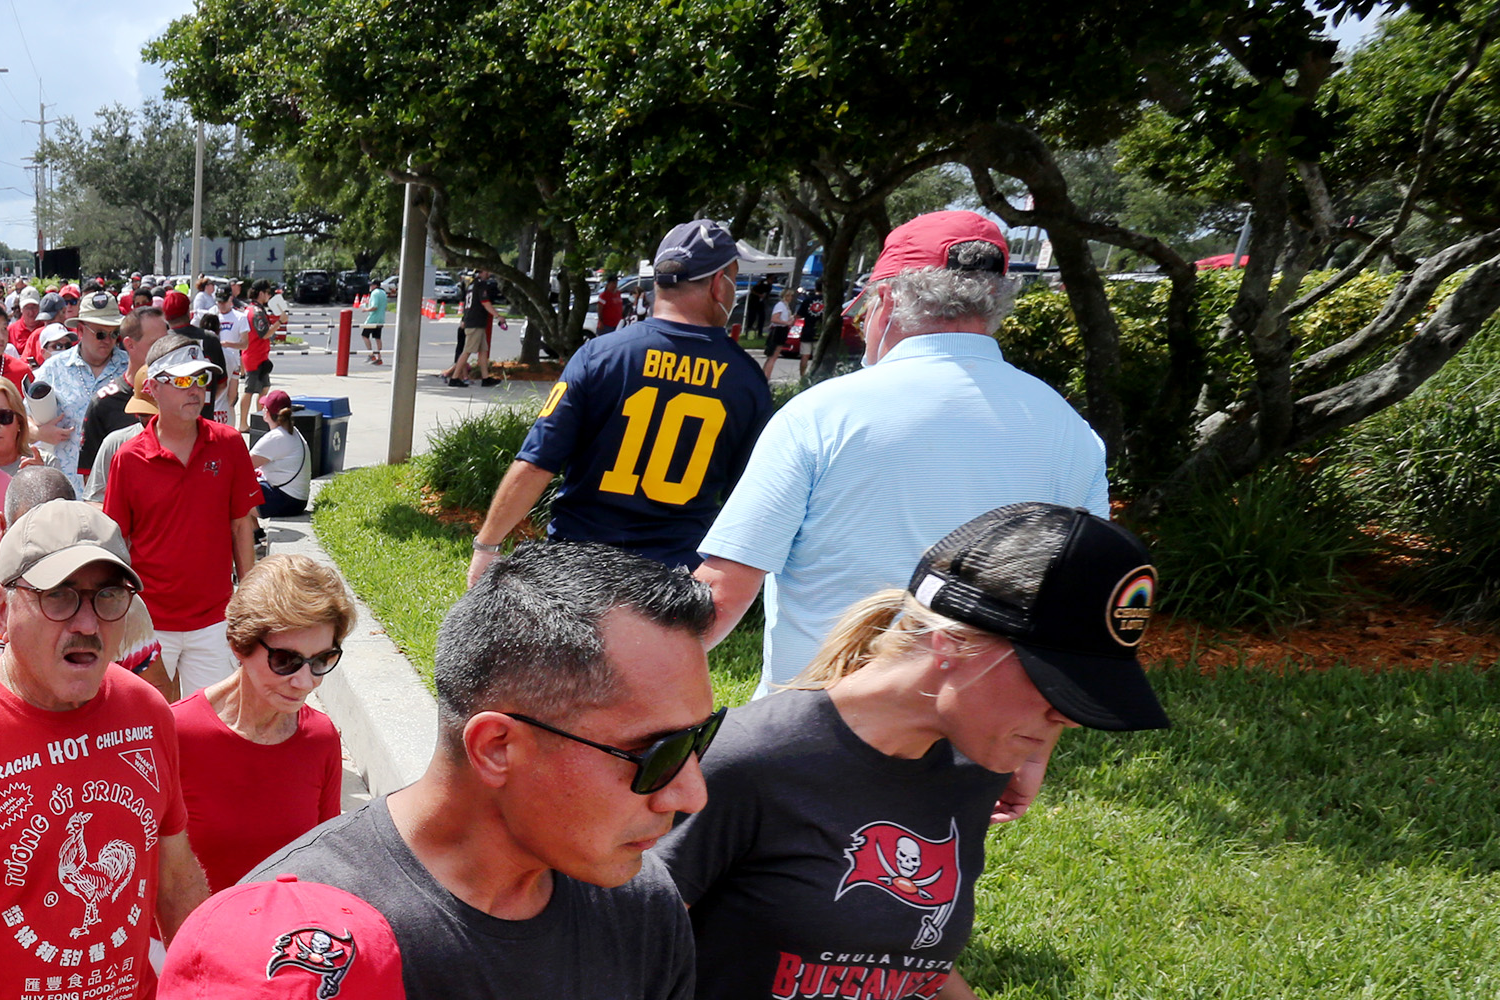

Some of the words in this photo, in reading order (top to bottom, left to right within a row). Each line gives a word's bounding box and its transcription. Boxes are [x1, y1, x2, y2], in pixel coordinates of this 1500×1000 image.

[642, 348, 728, 389] BRADY
[598, 386, 727, 506] 10
[47, 734, 90, 764] HOT
[96, 732, 124, 750] CHILI
[125, 726, 154, 742] SAUCE
[134, 759, 150, 778] WELL
[135, 752, 155, 773] SHAKE
[6, 797, 26, 815] COLOR
[82, 780, 159, 851] SRIRACHA
[820, 951, 891, 964] CHULA
[903, 956, 953, 971] VISTA
[117, 974, 135, 986] INC.
